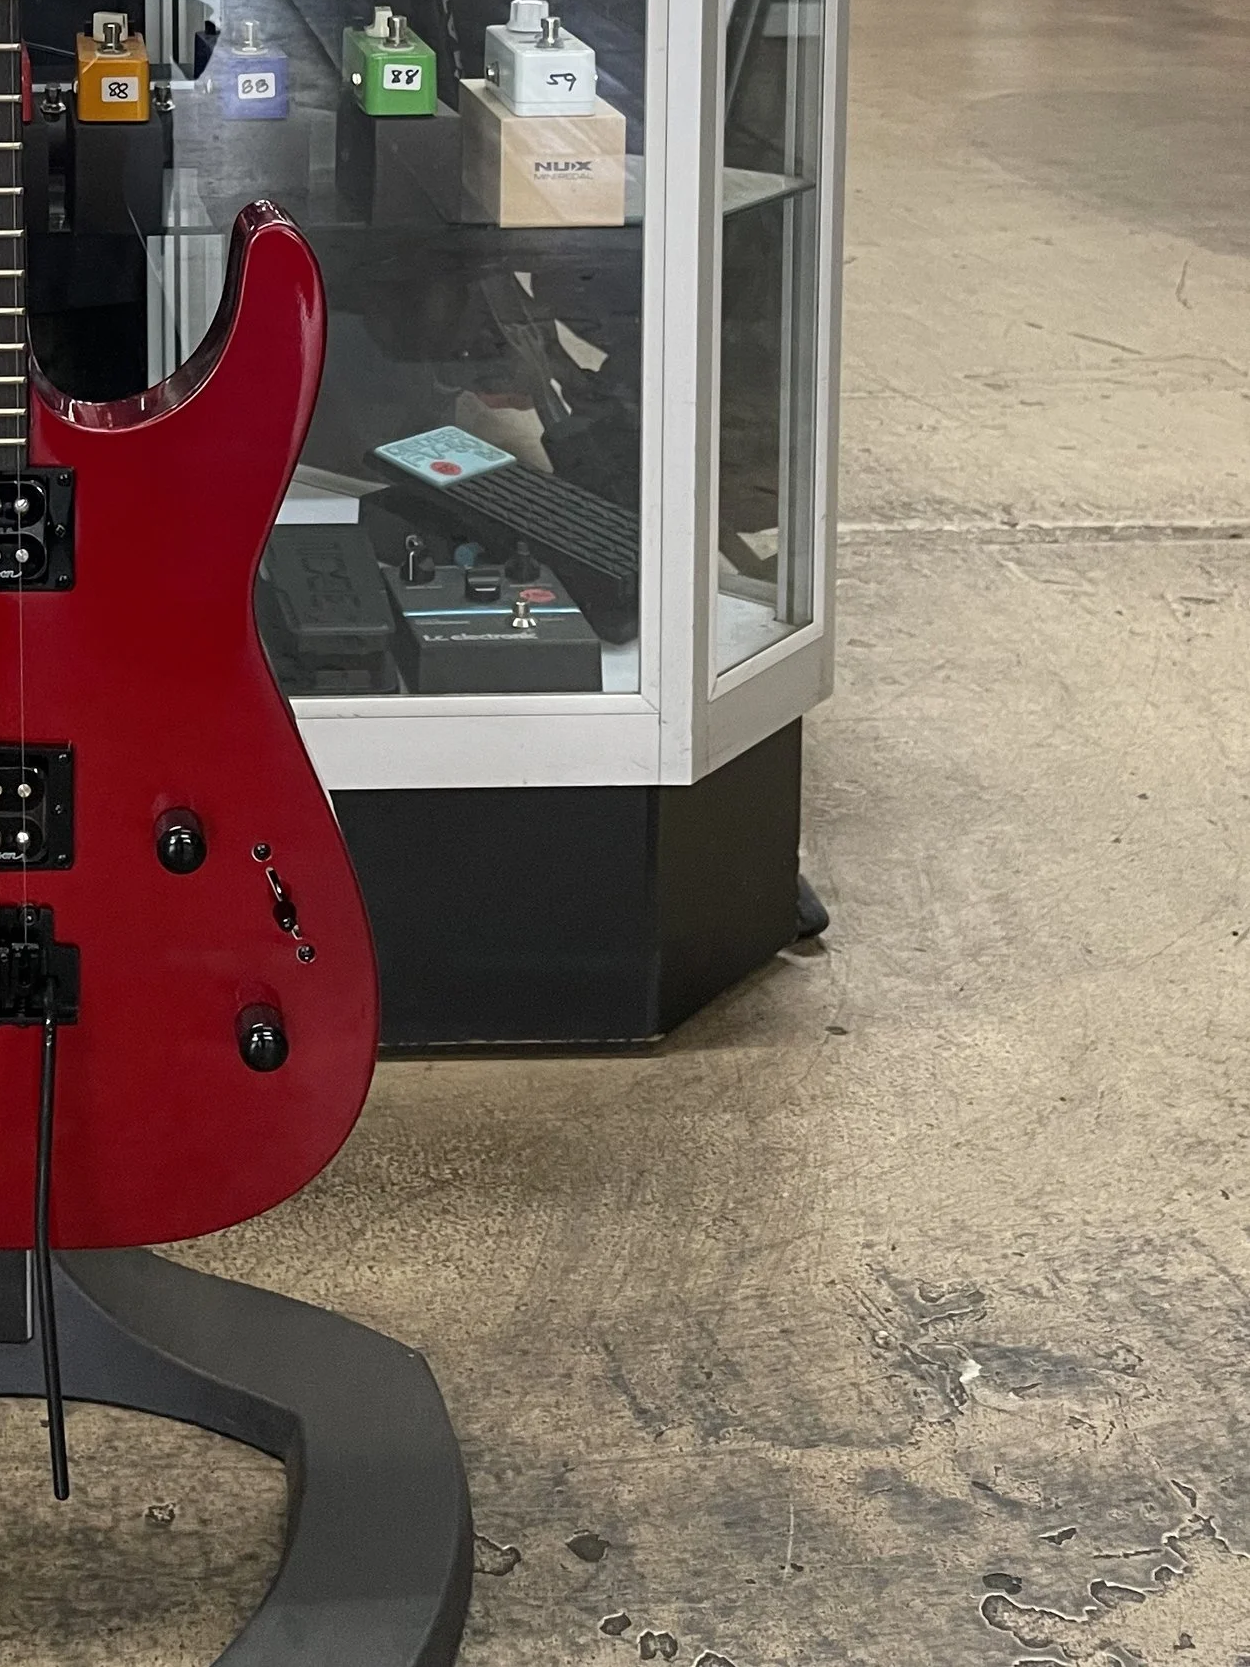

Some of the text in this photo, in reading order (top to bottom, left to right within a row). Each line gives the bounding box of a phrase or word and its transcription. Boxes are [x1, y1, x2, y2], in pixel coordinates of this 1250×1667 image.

[391, 68, 419, 84] 88
[546, 73, 577, 92] 59
[107, 81, 129, 99] 88
[241, 78, 270, 94] 88
[535, 161, 593, 172] NUX
